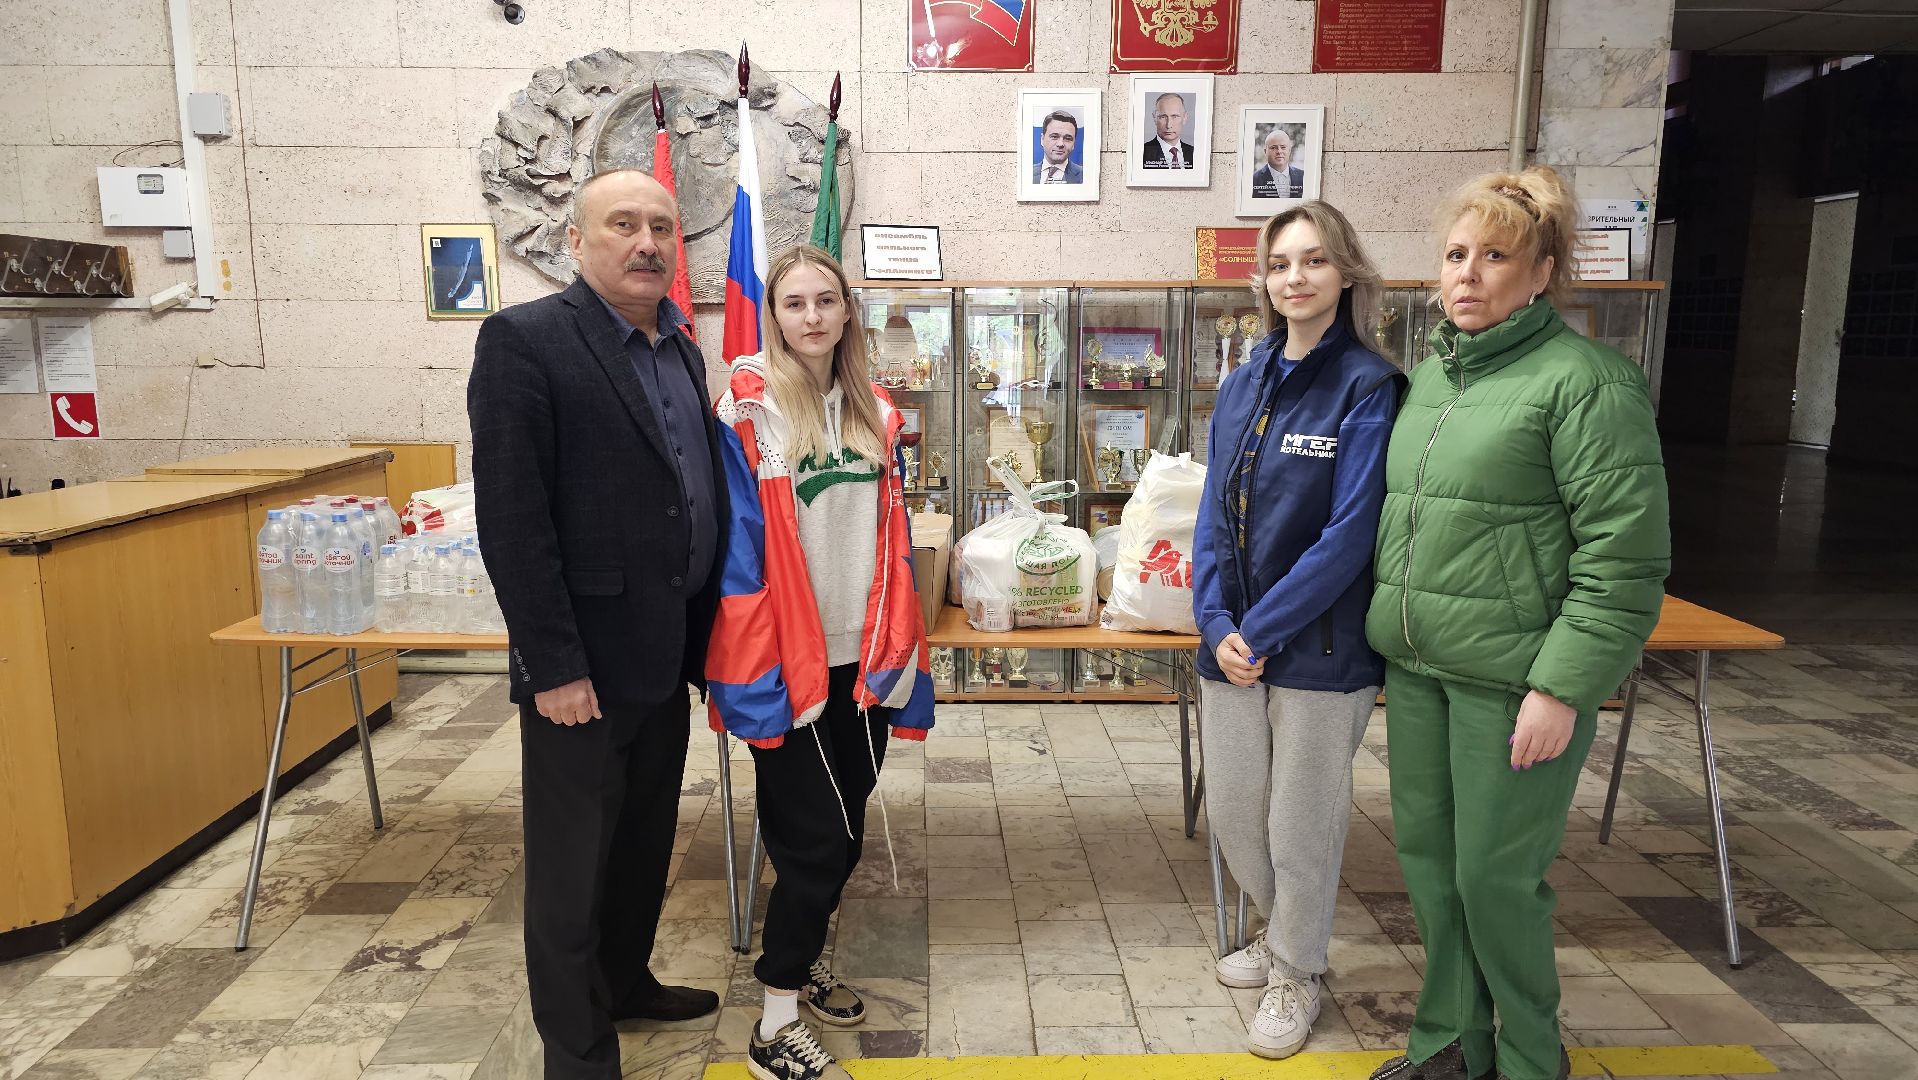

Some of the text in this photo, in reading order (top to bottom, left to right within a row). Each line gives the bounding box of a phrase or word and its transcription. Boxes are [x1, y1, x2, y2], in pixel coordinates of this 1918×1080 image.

[1588, 215, 1635, 223] ЗРИТЕЛЬНЫЙ
[1280, 445, 1337, 459] КОТЕЛЬНИК
[1025, 585, 1084, 597] RECYCLED
